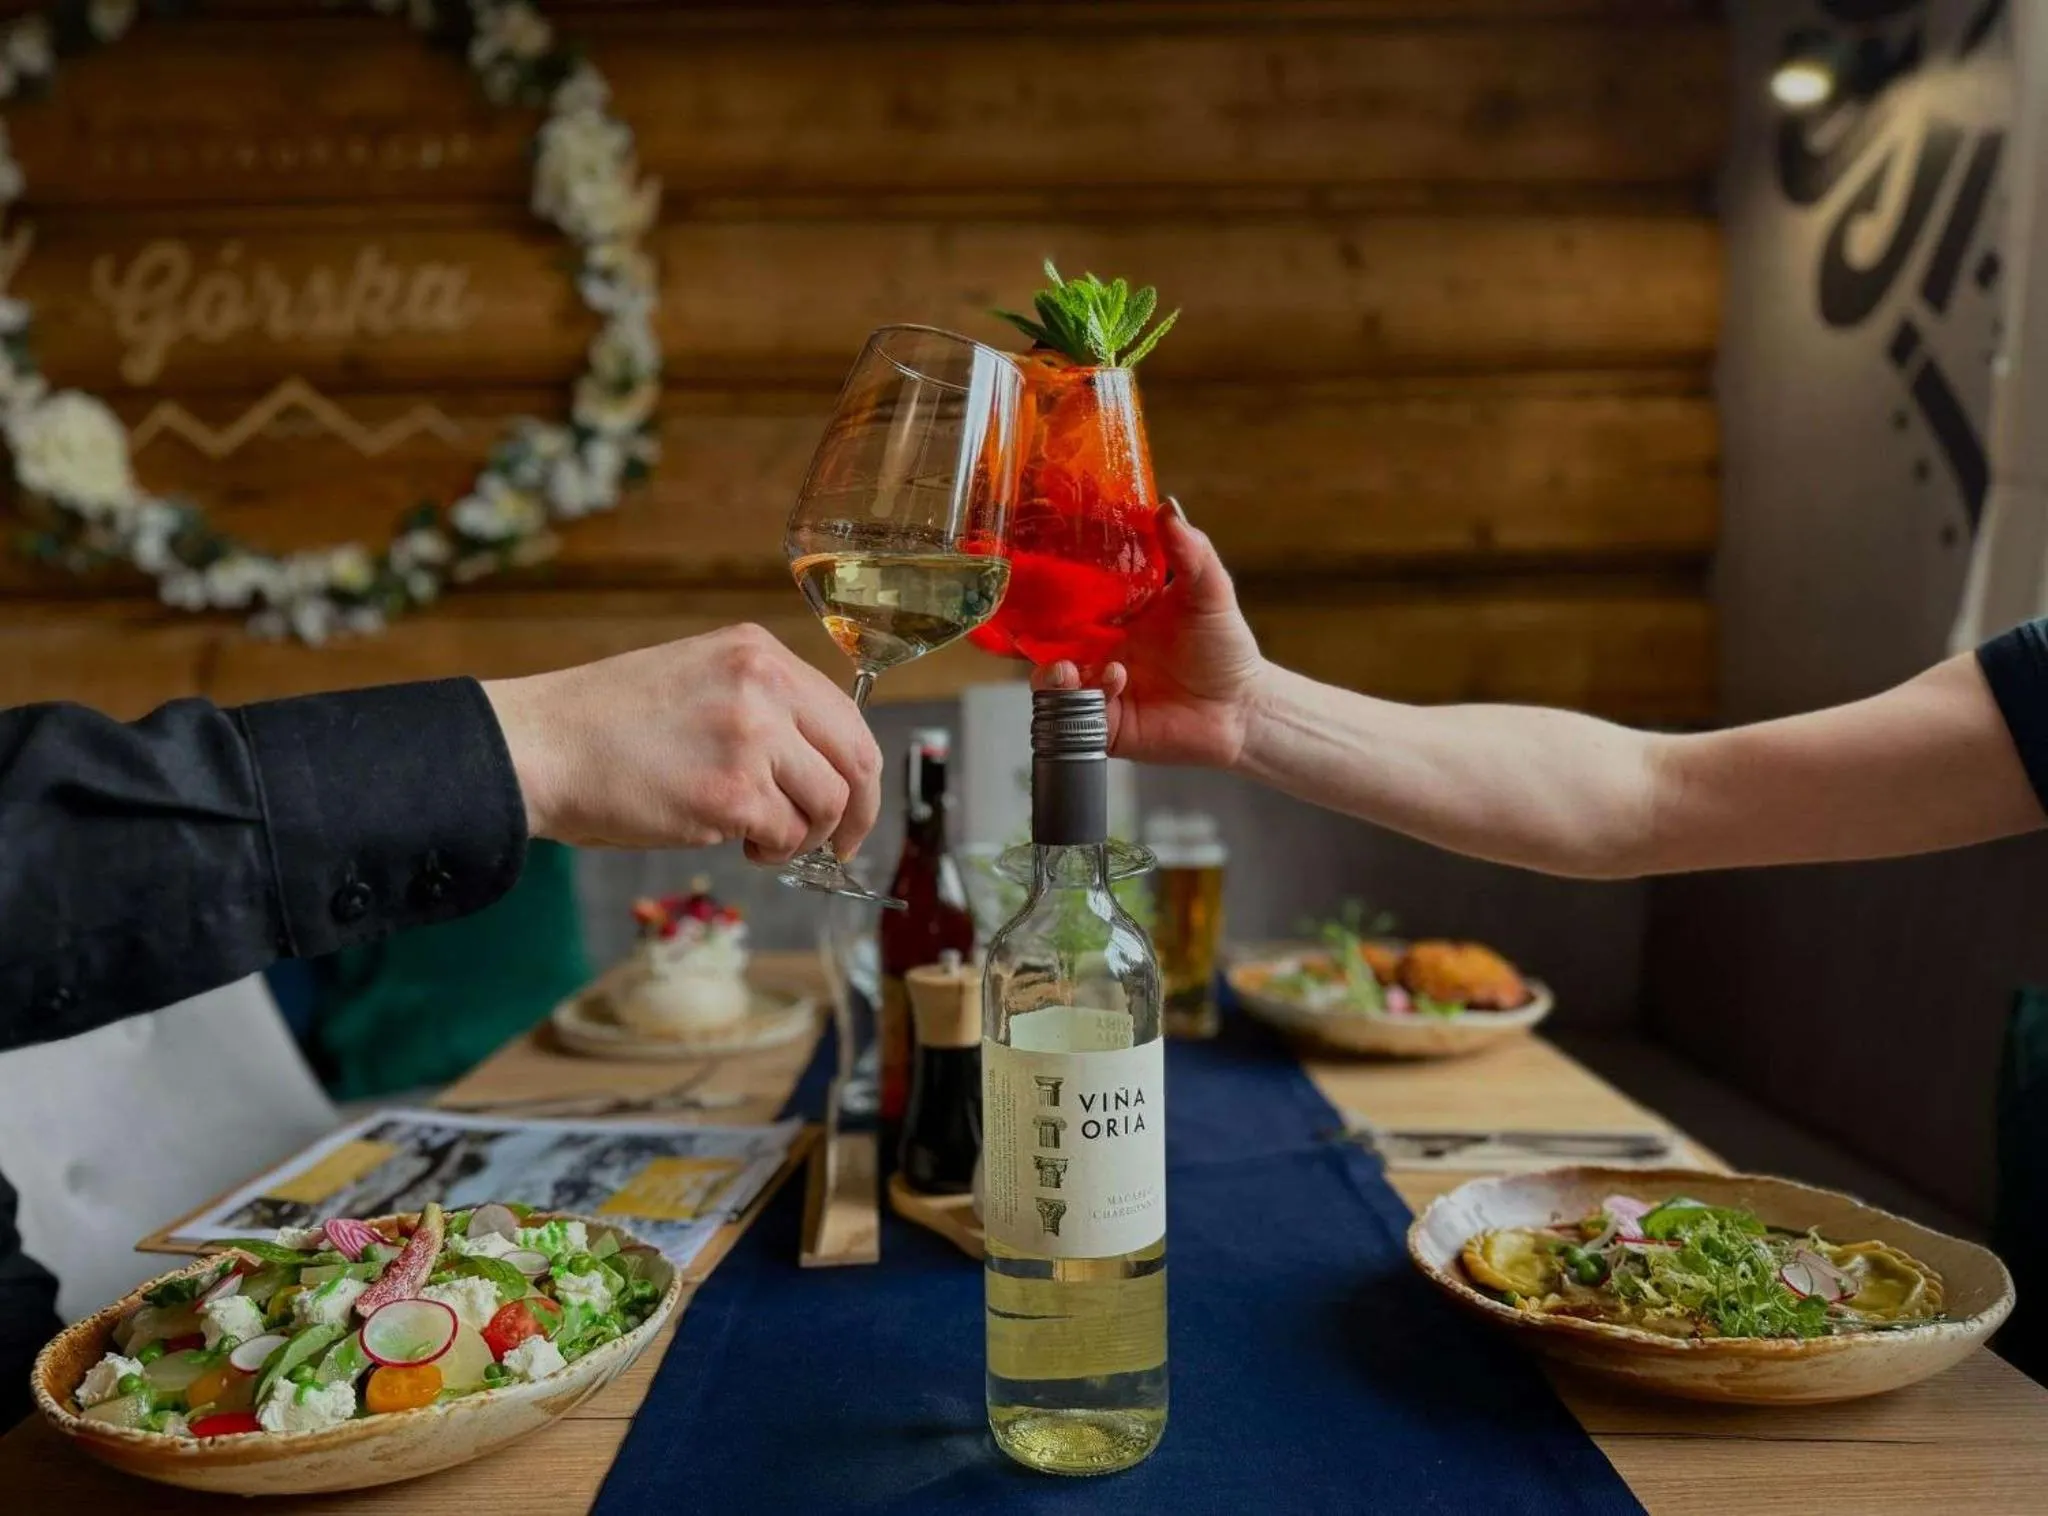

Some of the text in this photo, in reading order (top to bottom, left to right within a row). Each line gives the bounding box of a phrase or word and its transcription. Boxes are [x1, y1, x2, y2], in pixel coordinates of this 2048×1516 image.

[90, 239, 477, 386] Górska
[1078, 1086, 1145, 1113] VIÑA
[1081, 1112, 1145, 1140] ORIA
